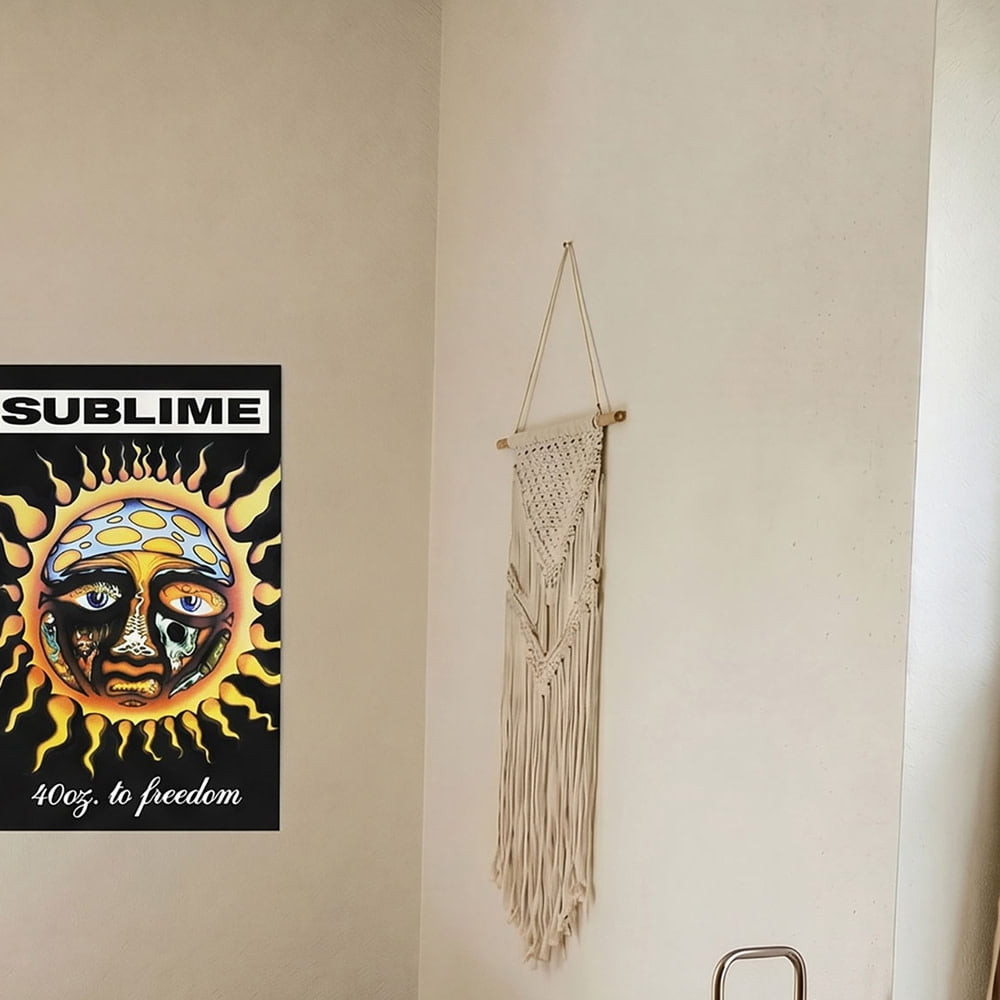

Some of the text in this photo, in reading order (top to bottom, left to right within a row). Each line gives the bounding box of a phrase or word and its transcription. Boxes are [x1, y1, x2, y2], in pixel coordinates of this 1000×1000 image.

[1, 396, 261, 425] SUBLIME
[31, 776, 243, 819] 40oz. to freedom
